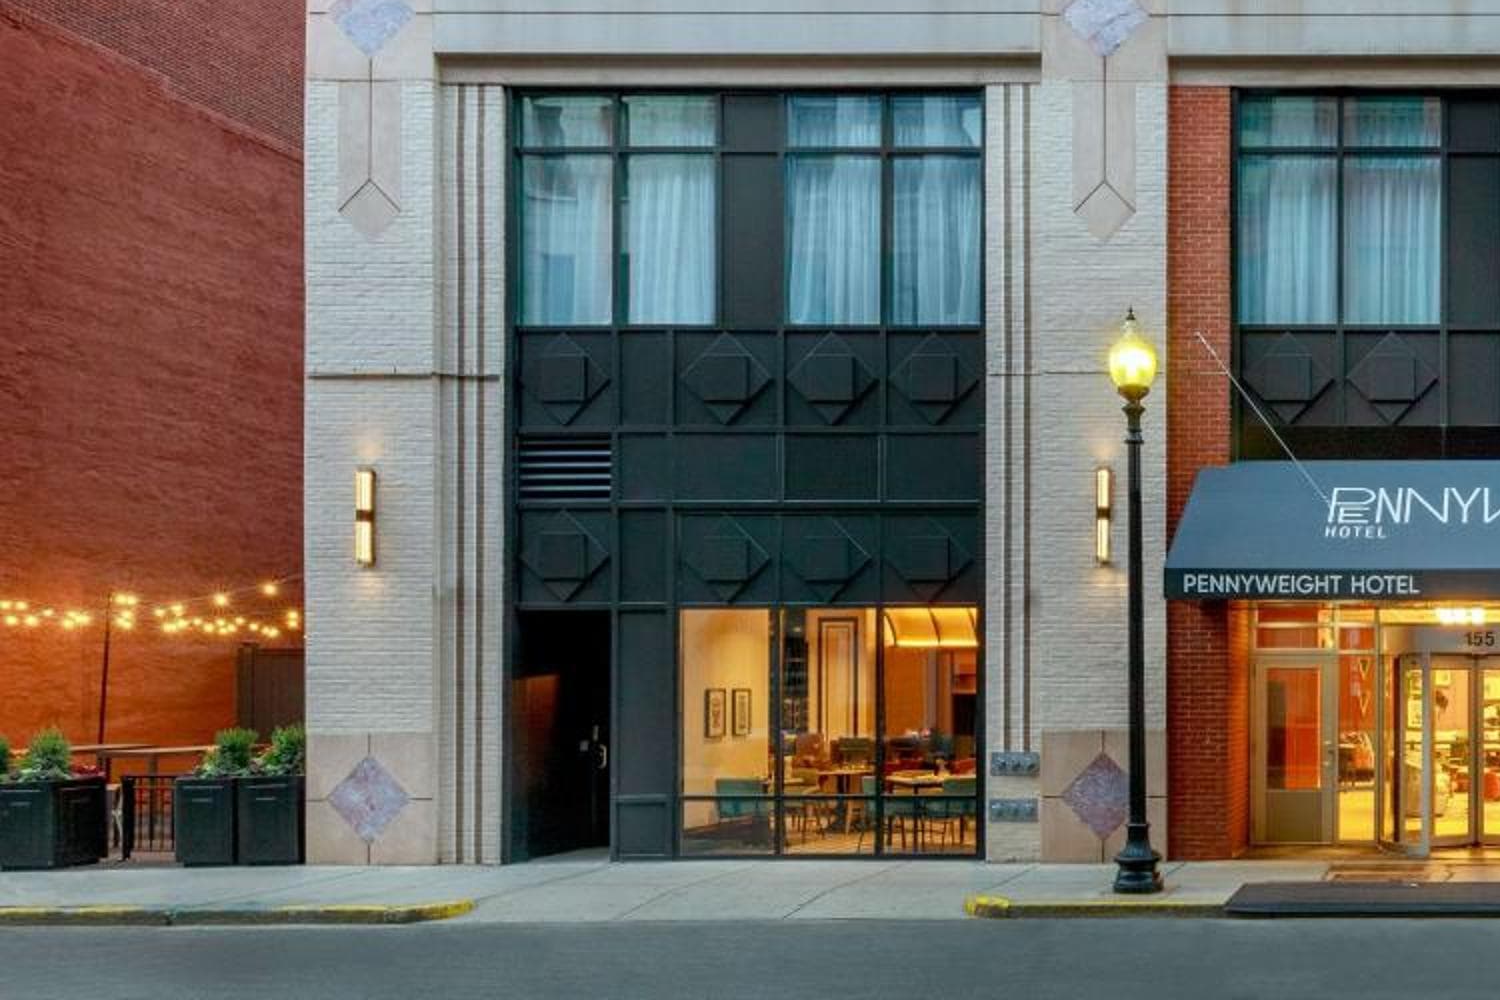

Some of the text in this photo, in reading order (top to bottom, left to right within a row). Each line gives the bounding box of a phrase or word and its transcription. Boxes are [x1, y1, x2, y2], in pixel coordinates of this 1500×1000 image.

[1324, 525, 1387, 539] HOTEL
[1183, 574, 1420, 594] PENNYWEIGHT HOTEL
[1465, 631, 1495, 647] 155
